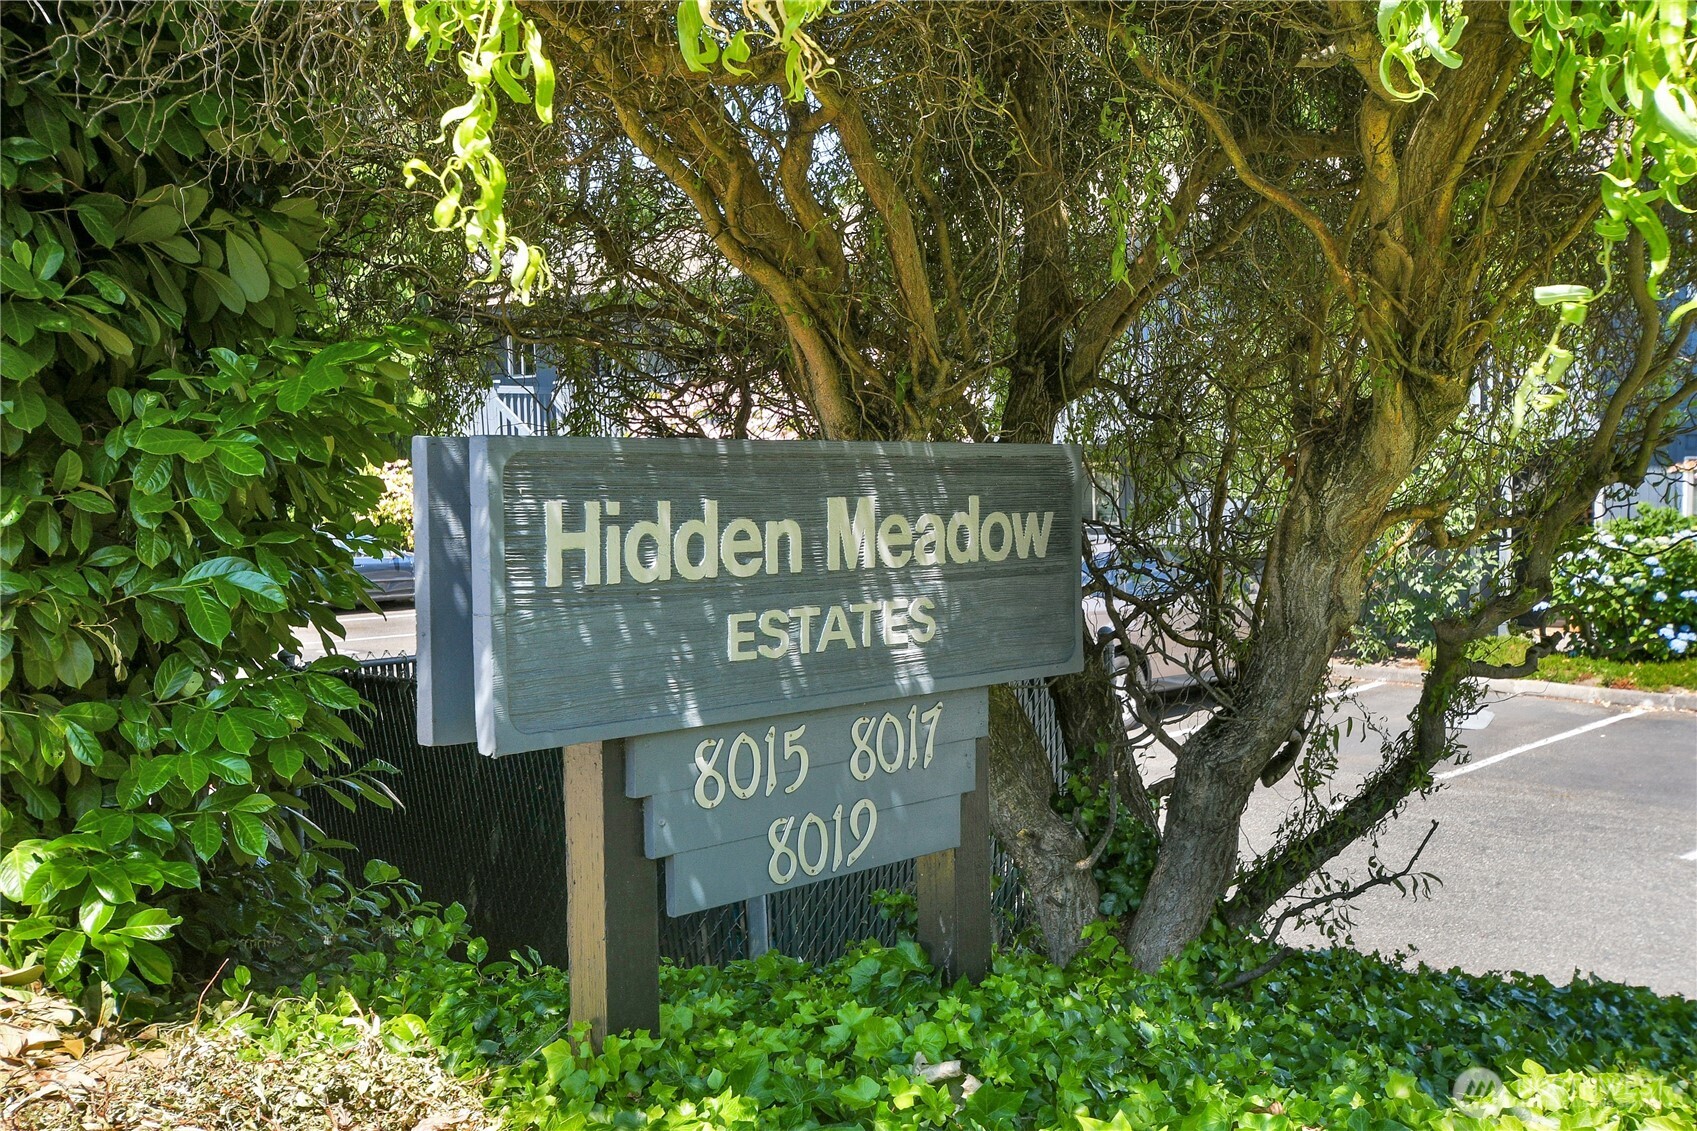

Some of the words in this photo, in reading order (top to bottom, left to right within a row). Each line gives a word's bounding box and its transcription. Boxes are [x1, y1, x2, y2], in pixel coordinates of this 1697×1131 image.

[544, 499, 802, 588] Hidden
[826, 494, 1054, 572] Meadow
[727, 597, 936, 662] ESTATES
[694, 724, 809, 809] 8015
[849, 701, 944, 782] 8017
[767, 798, 878, 885] 8019
